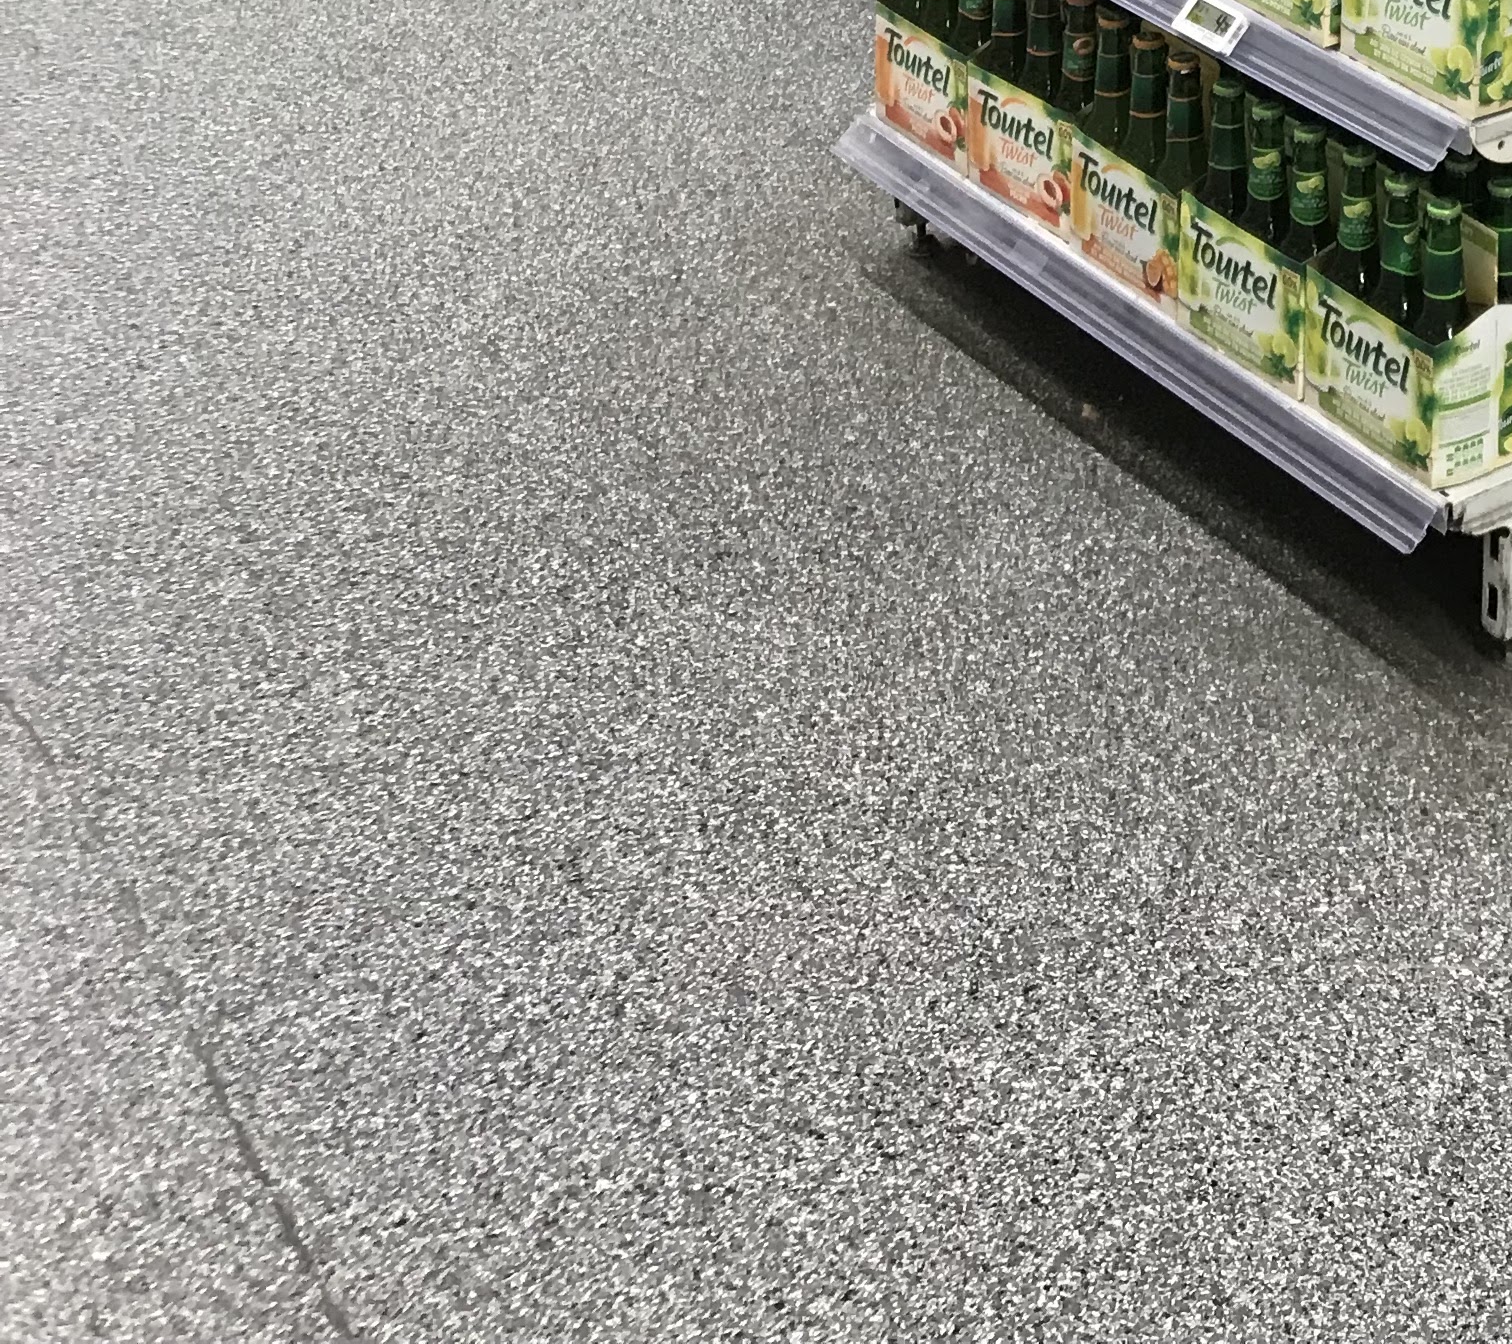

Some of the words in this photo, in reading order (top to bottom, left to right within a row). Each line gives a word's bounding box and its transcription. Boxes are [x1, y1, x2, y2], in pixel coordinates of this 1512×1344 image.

[883, 25, 951, 99] Tourtel
[977, 87, 1056, 162] Tourtel
[1078, 150, 1160, 237] Tourtel
[1190, 219, 1278, 312] Tourtel
[1318, 291, 1412, 396] Tourtel
